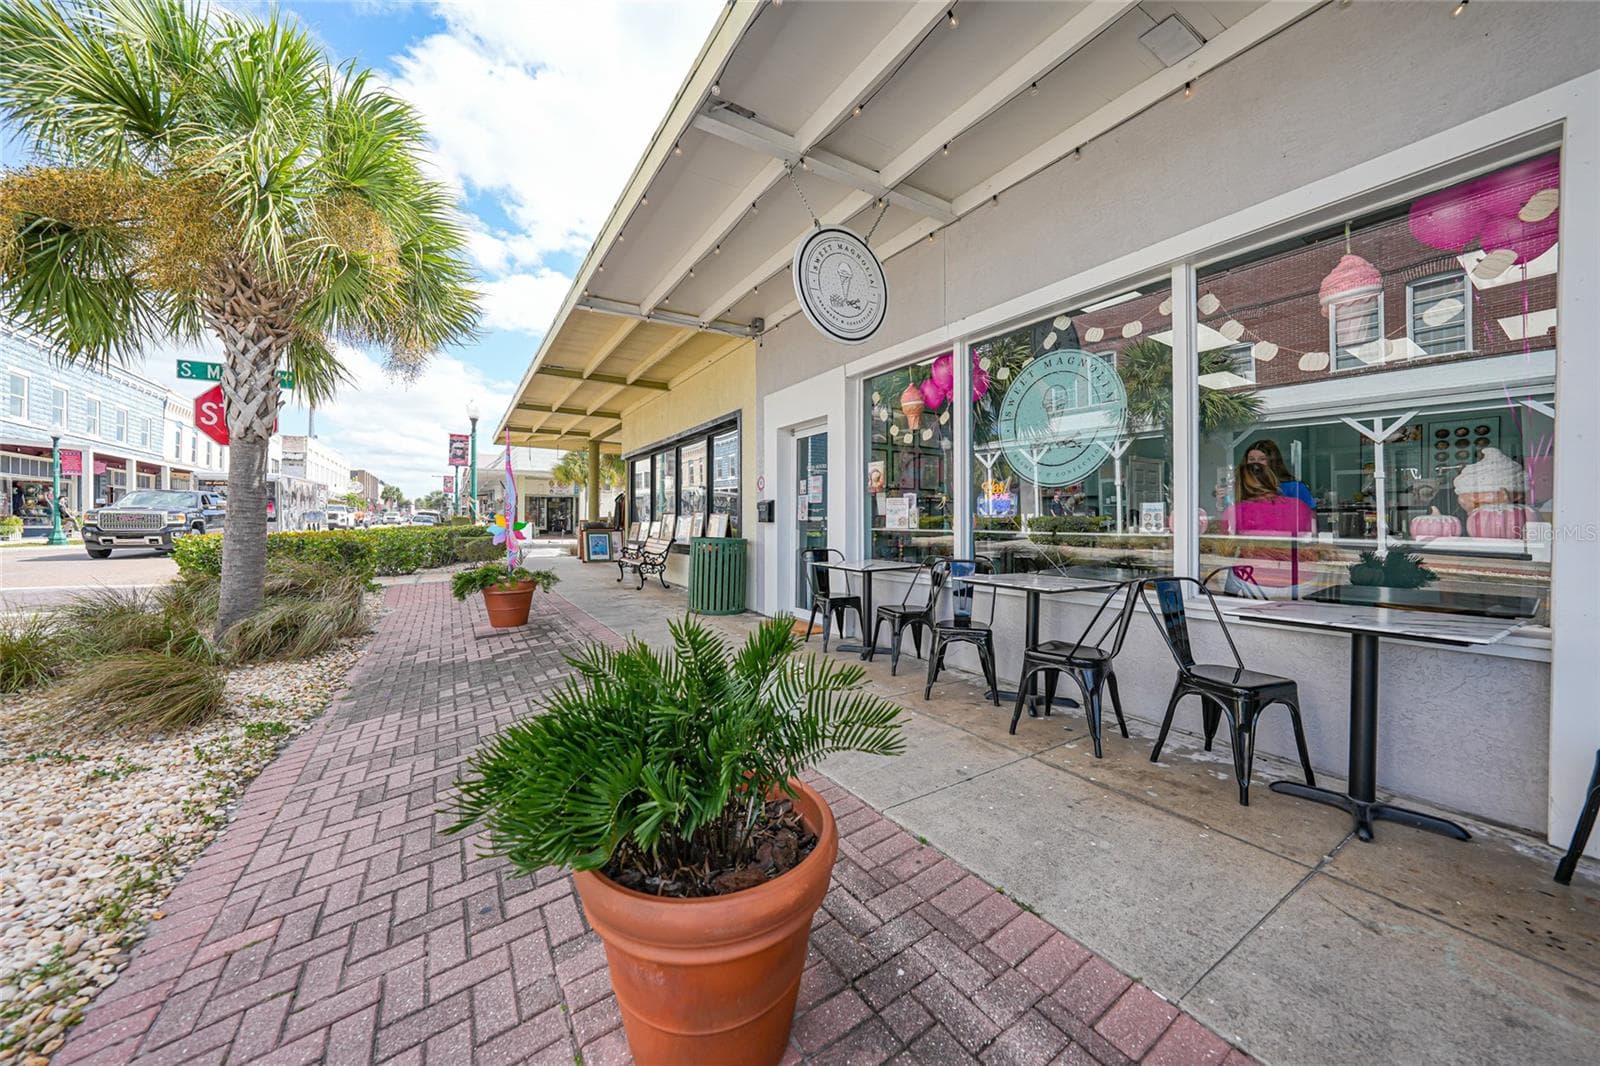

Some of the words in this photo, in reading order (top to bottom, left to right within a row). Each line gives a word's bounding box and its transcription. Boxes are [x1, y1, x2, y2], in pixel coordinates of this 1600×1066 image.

[813, 244, 832, 271] SWEET
[838, 243, 875, 285] MAGNOLIA
[180, 362, 197, 378] S.
[1005, 370, 1034, 417] SWEET
[1043, 356, 1114, 399] MAGNOLIA
